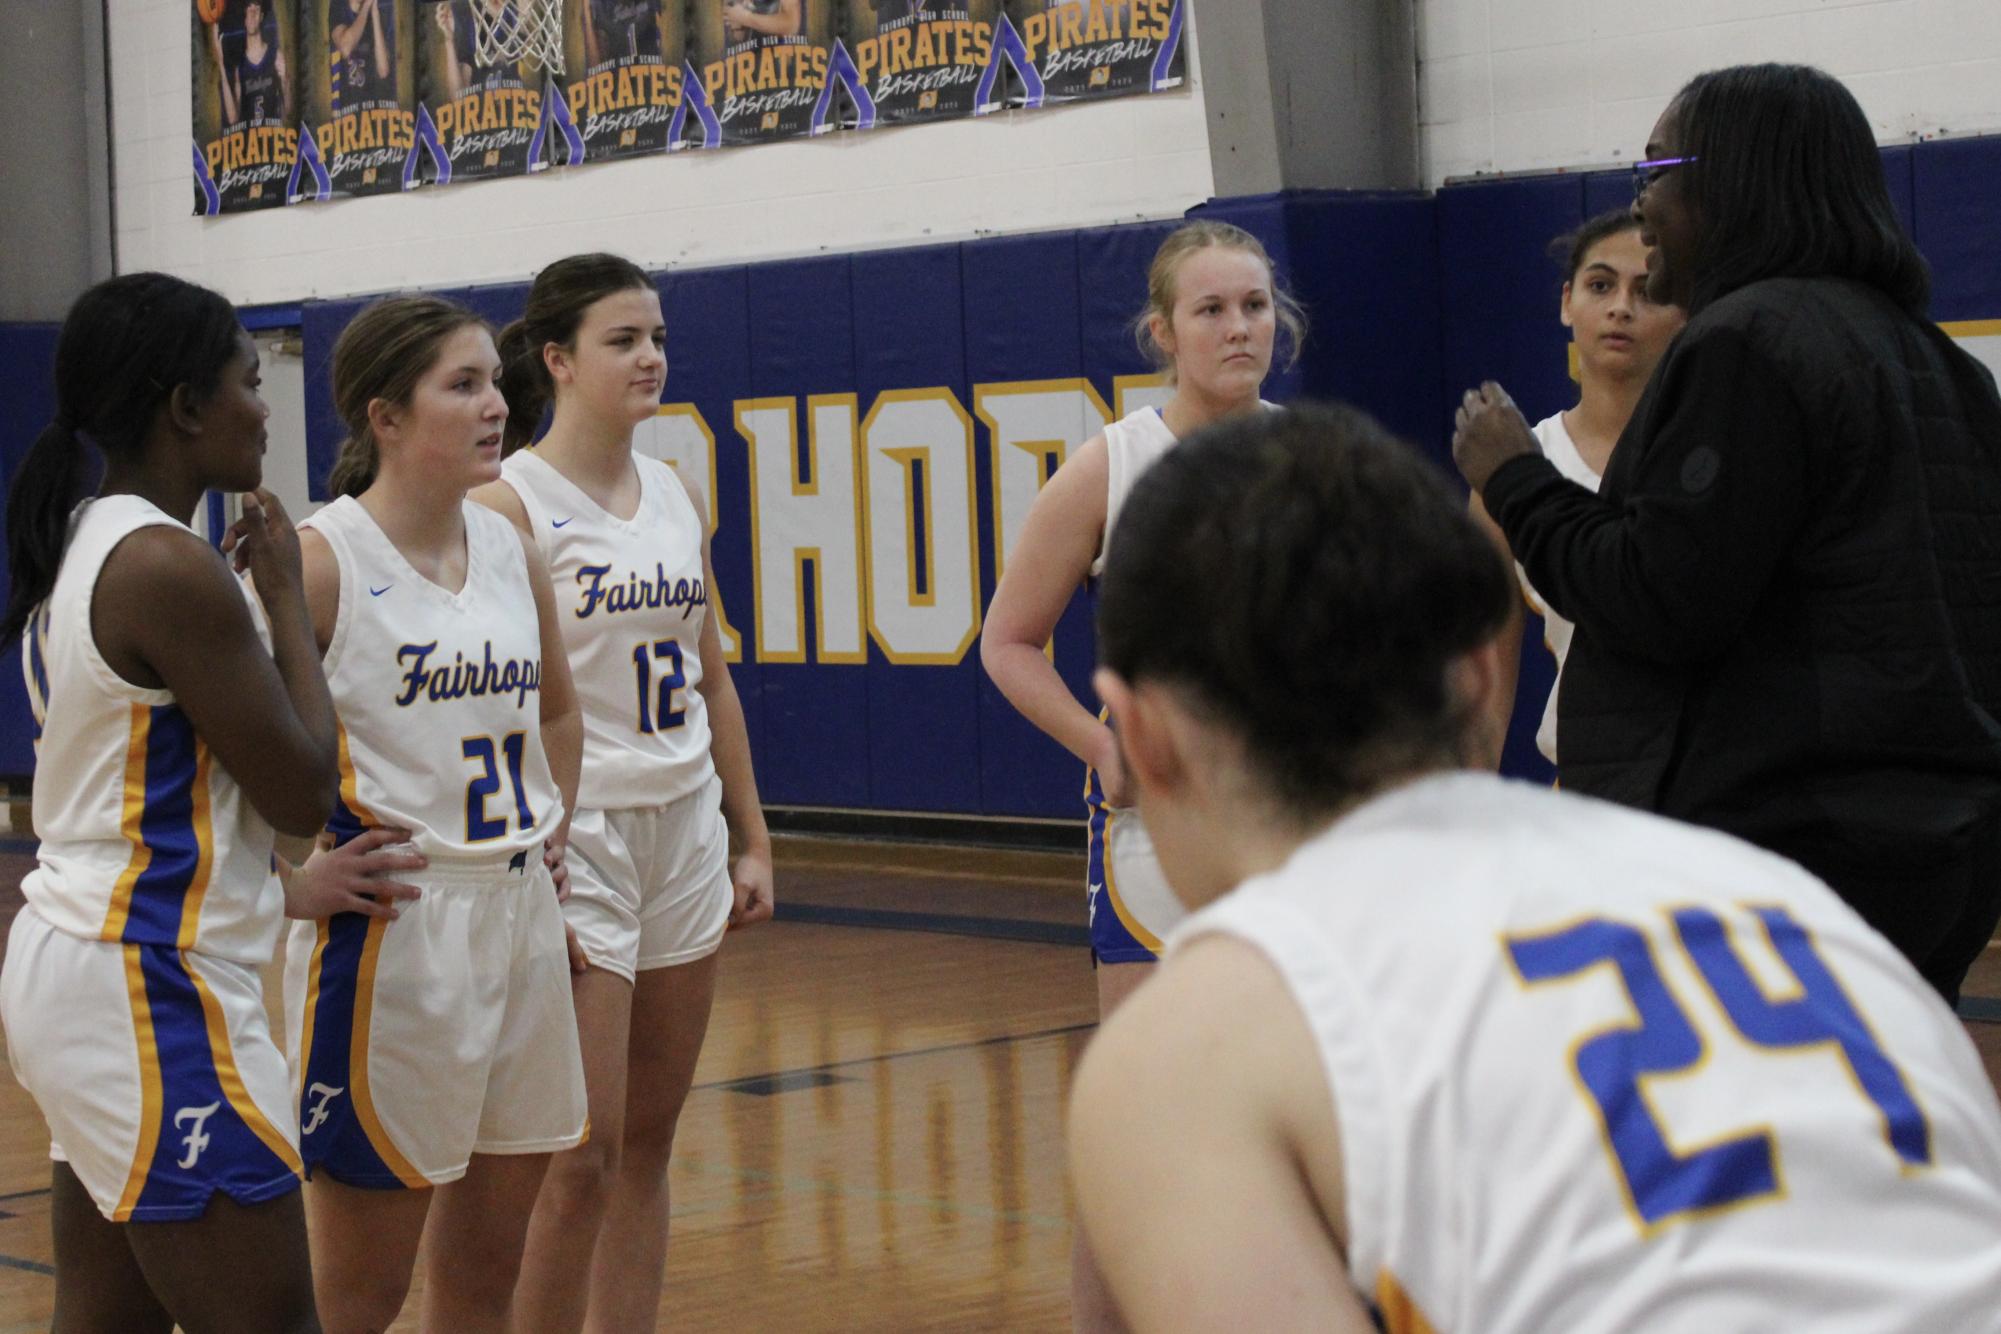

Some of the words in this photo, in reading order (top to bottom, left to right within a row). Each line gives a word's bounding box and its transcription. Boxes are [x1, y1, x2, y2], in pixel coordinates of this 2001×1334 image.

[856, 20, 992, 87] PIRATES
[1024, 0, 1170, 63] PIRATES
[1042, 37, 1153, 80] BASKETBALL
[568, 64, 682, 126] PIRATES
[704, 44, 828, 107] PIRATES
[874, 62, 977, 103] BASKETBALL
[436, 88, 540, 146] PIRATES
[583, 104, 669, 141] BASKETBALL
[720, 86, 815, 124] BASKETBALL
[207, 127, 298, 179] PIRATES
[317, 109, 414, 164] PIRATES
[330, 146, 405, 178] BASKETBALL
[450, 127, 530, 161] BASKETBALL
[219, 162, 289, 193] BASKETBALL
[575, 562, 707, 621] Fairhop
[395, 640, 541, 709] Fairhop
[632, 637, 689, 737] 12
[461, 729, 539, 844] 21
[1497, 900, 1937, 1241] 24
[173, 1100, 222, 1170] F
[302, 1081, 345, 1136] F
